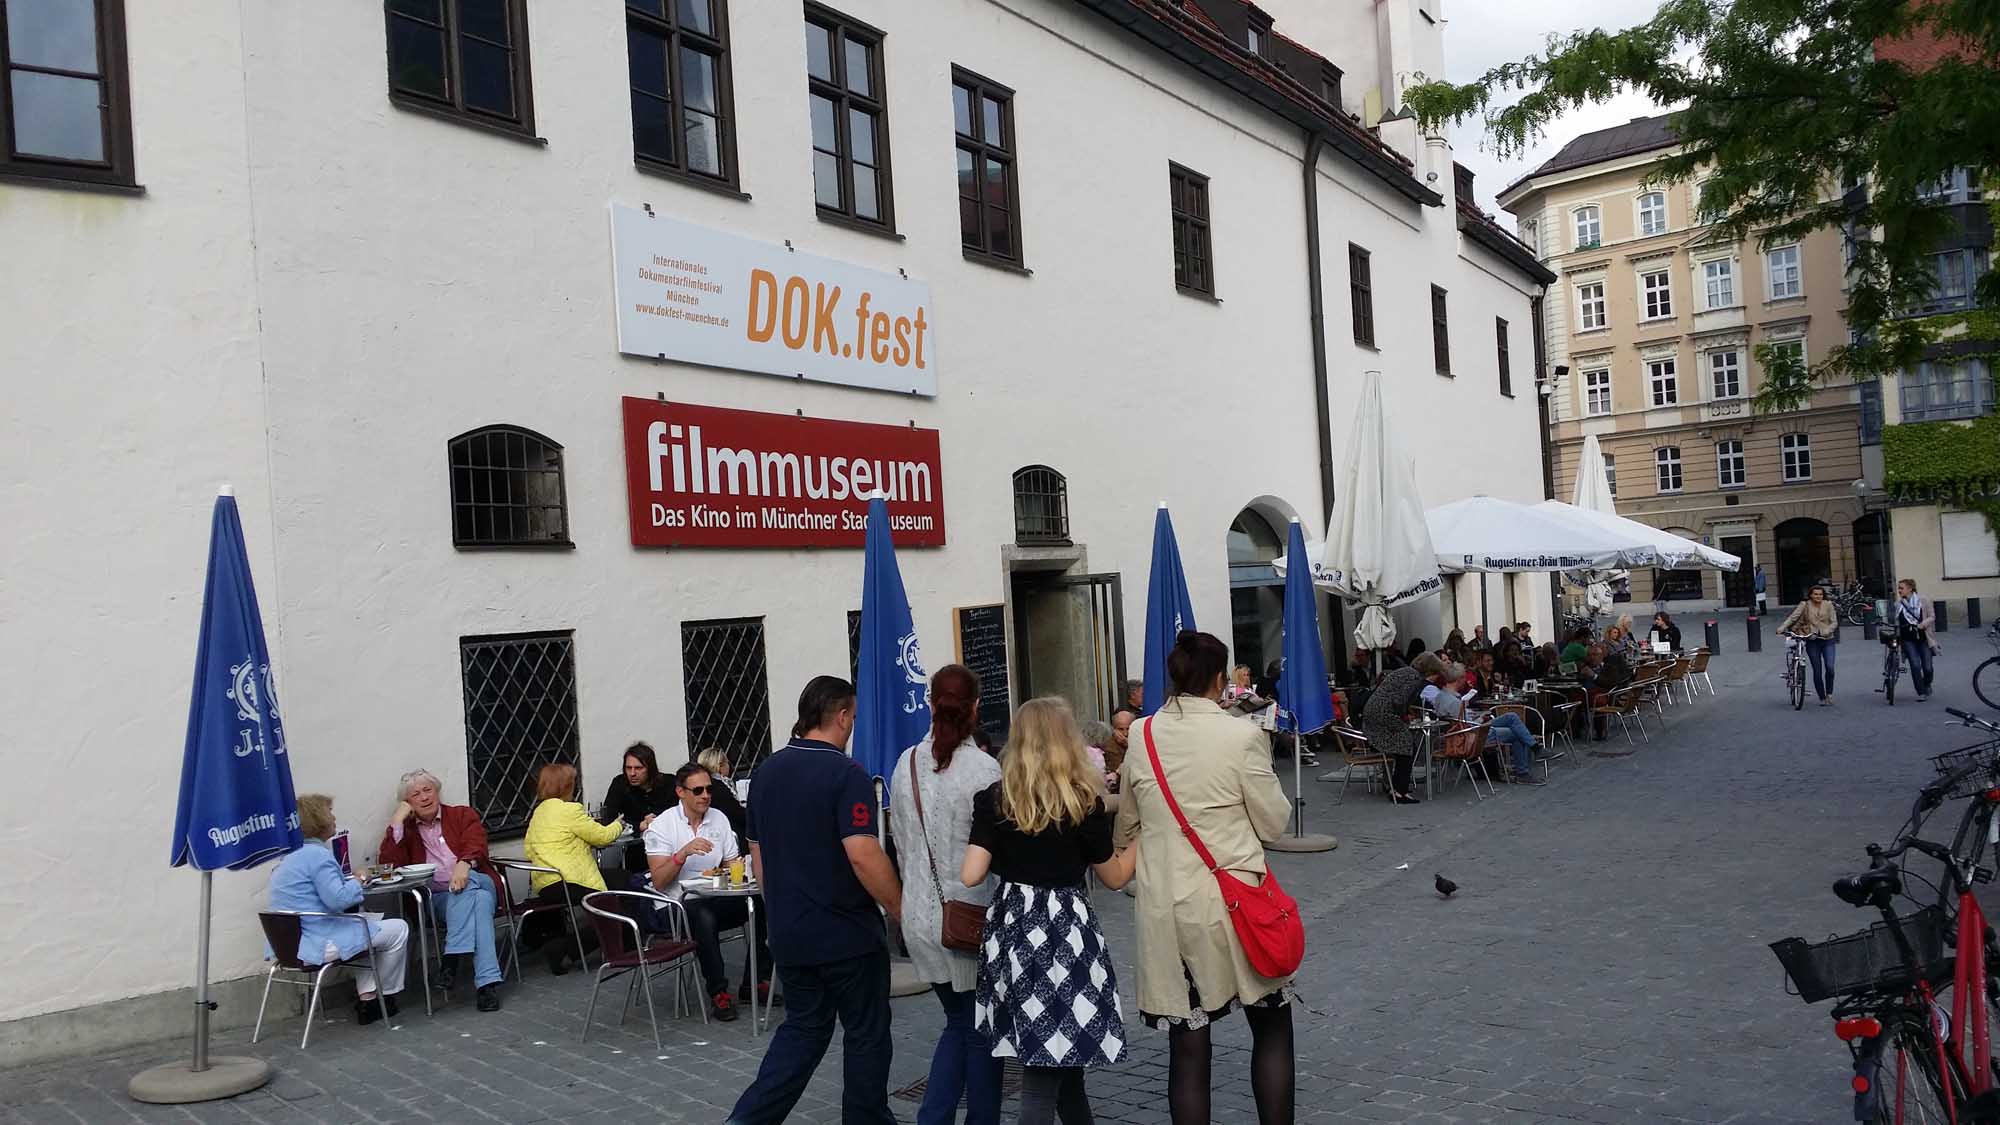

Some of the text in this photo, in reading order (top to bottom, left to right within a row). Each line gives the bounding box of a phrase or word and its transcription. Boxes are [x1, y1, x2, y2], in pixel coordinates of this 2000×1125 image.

[653, 254, 708, 275] Internationales
[639, 267, 722, 294] Dokumentarfilmfestival
[666, 290, 699, 305] München
[636, 303, 729, 328] www.dokfest-muenchen.de
[747, 268, 927, 369] DOK.fest
[647, 421, 932, 502] filmmuseum
[651, 503, 686, 527] Das
[691, 504, 731, 528] Kino
[736, 505, 756, 529] im
[762, 507, 837, 530] Münchner
